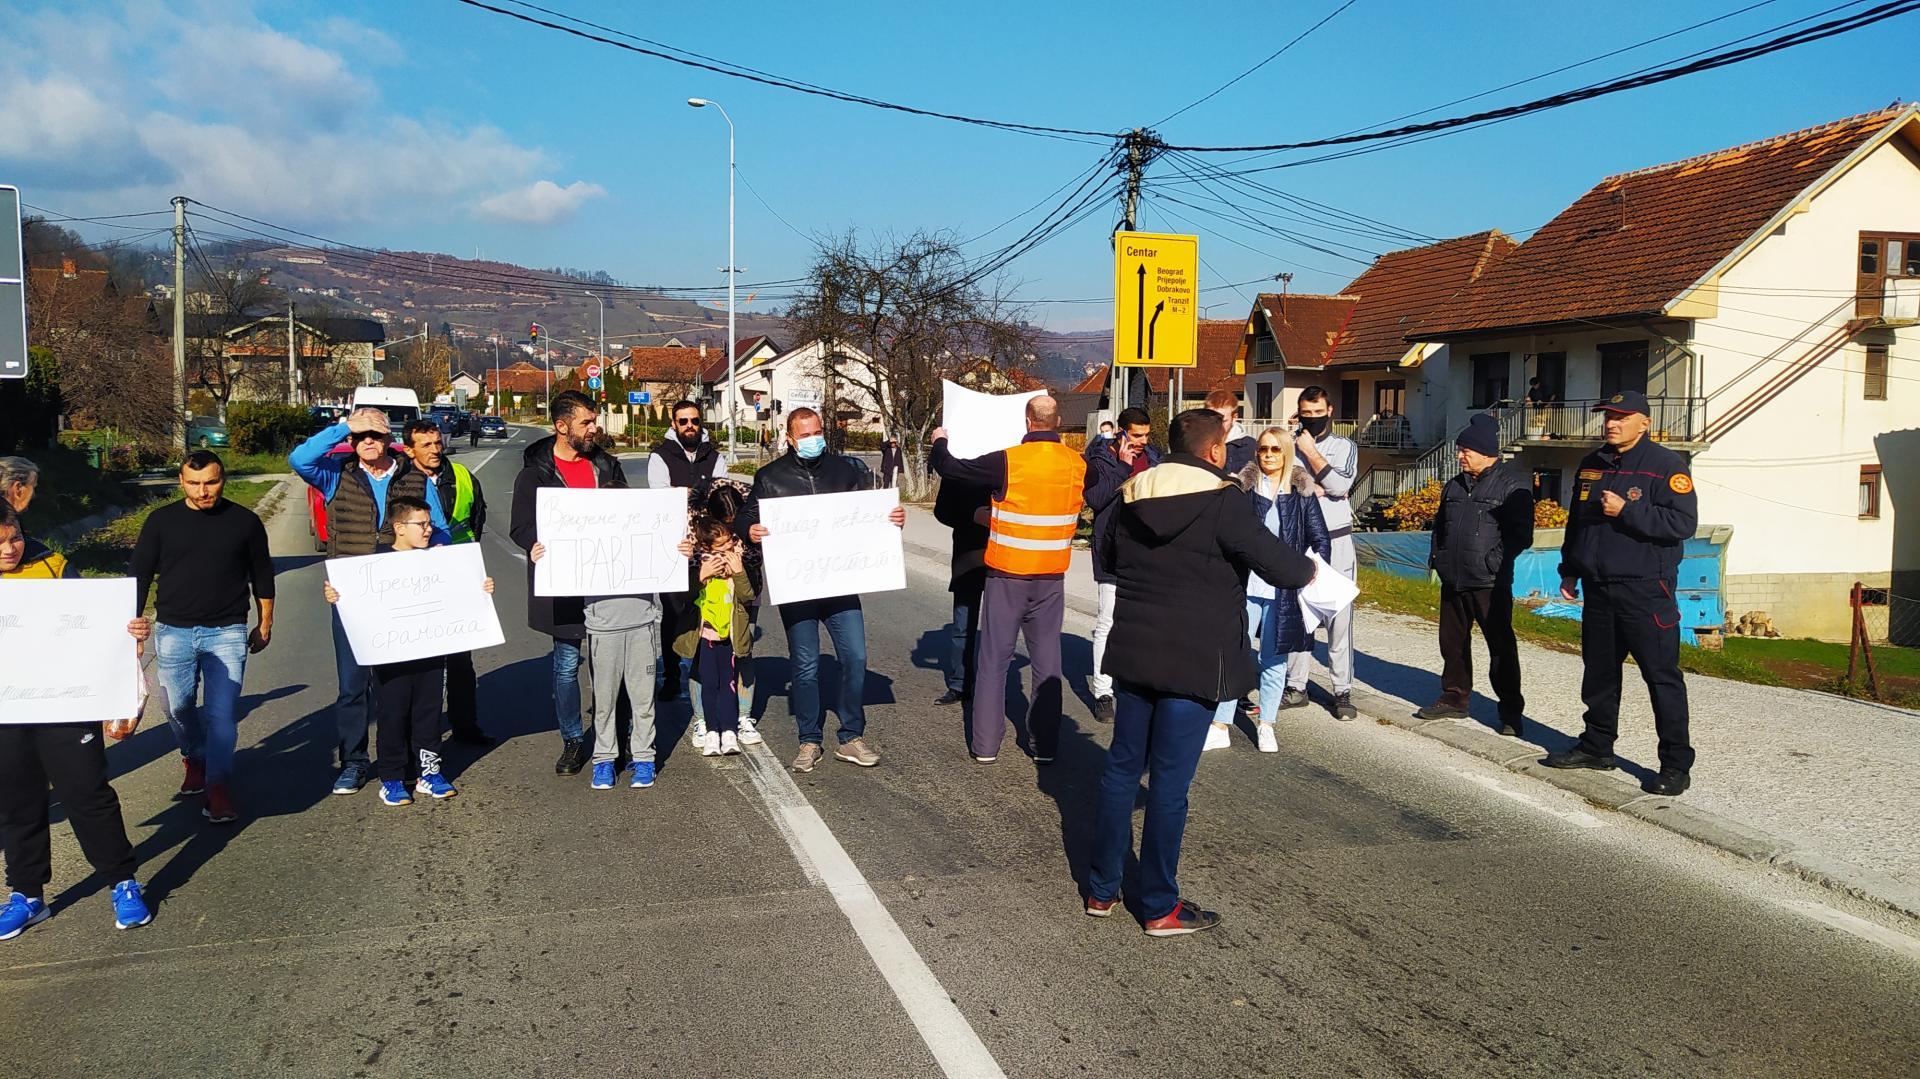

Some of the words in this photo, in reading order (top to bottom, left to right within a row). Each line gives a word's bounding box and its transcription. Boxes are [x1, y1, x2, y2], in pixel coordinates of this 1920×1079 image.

[1126, 245, 1158, 258] Centar
[1157, 267, 1184, 276] Beograd
[1157, 275, 1187, 285] Prijepolje
[1157, 285, 1191, 294] Dobrakovo
[1168, 296, 1190, 305] Tranzit
[622, 512, 641, 531] је
[651, 513, 673, 530] за
[549, 532, 681, 593] ПРАВДУ
[358, 557, 447, 601] Пресуда
[371, 618, 487, 649] срамота
